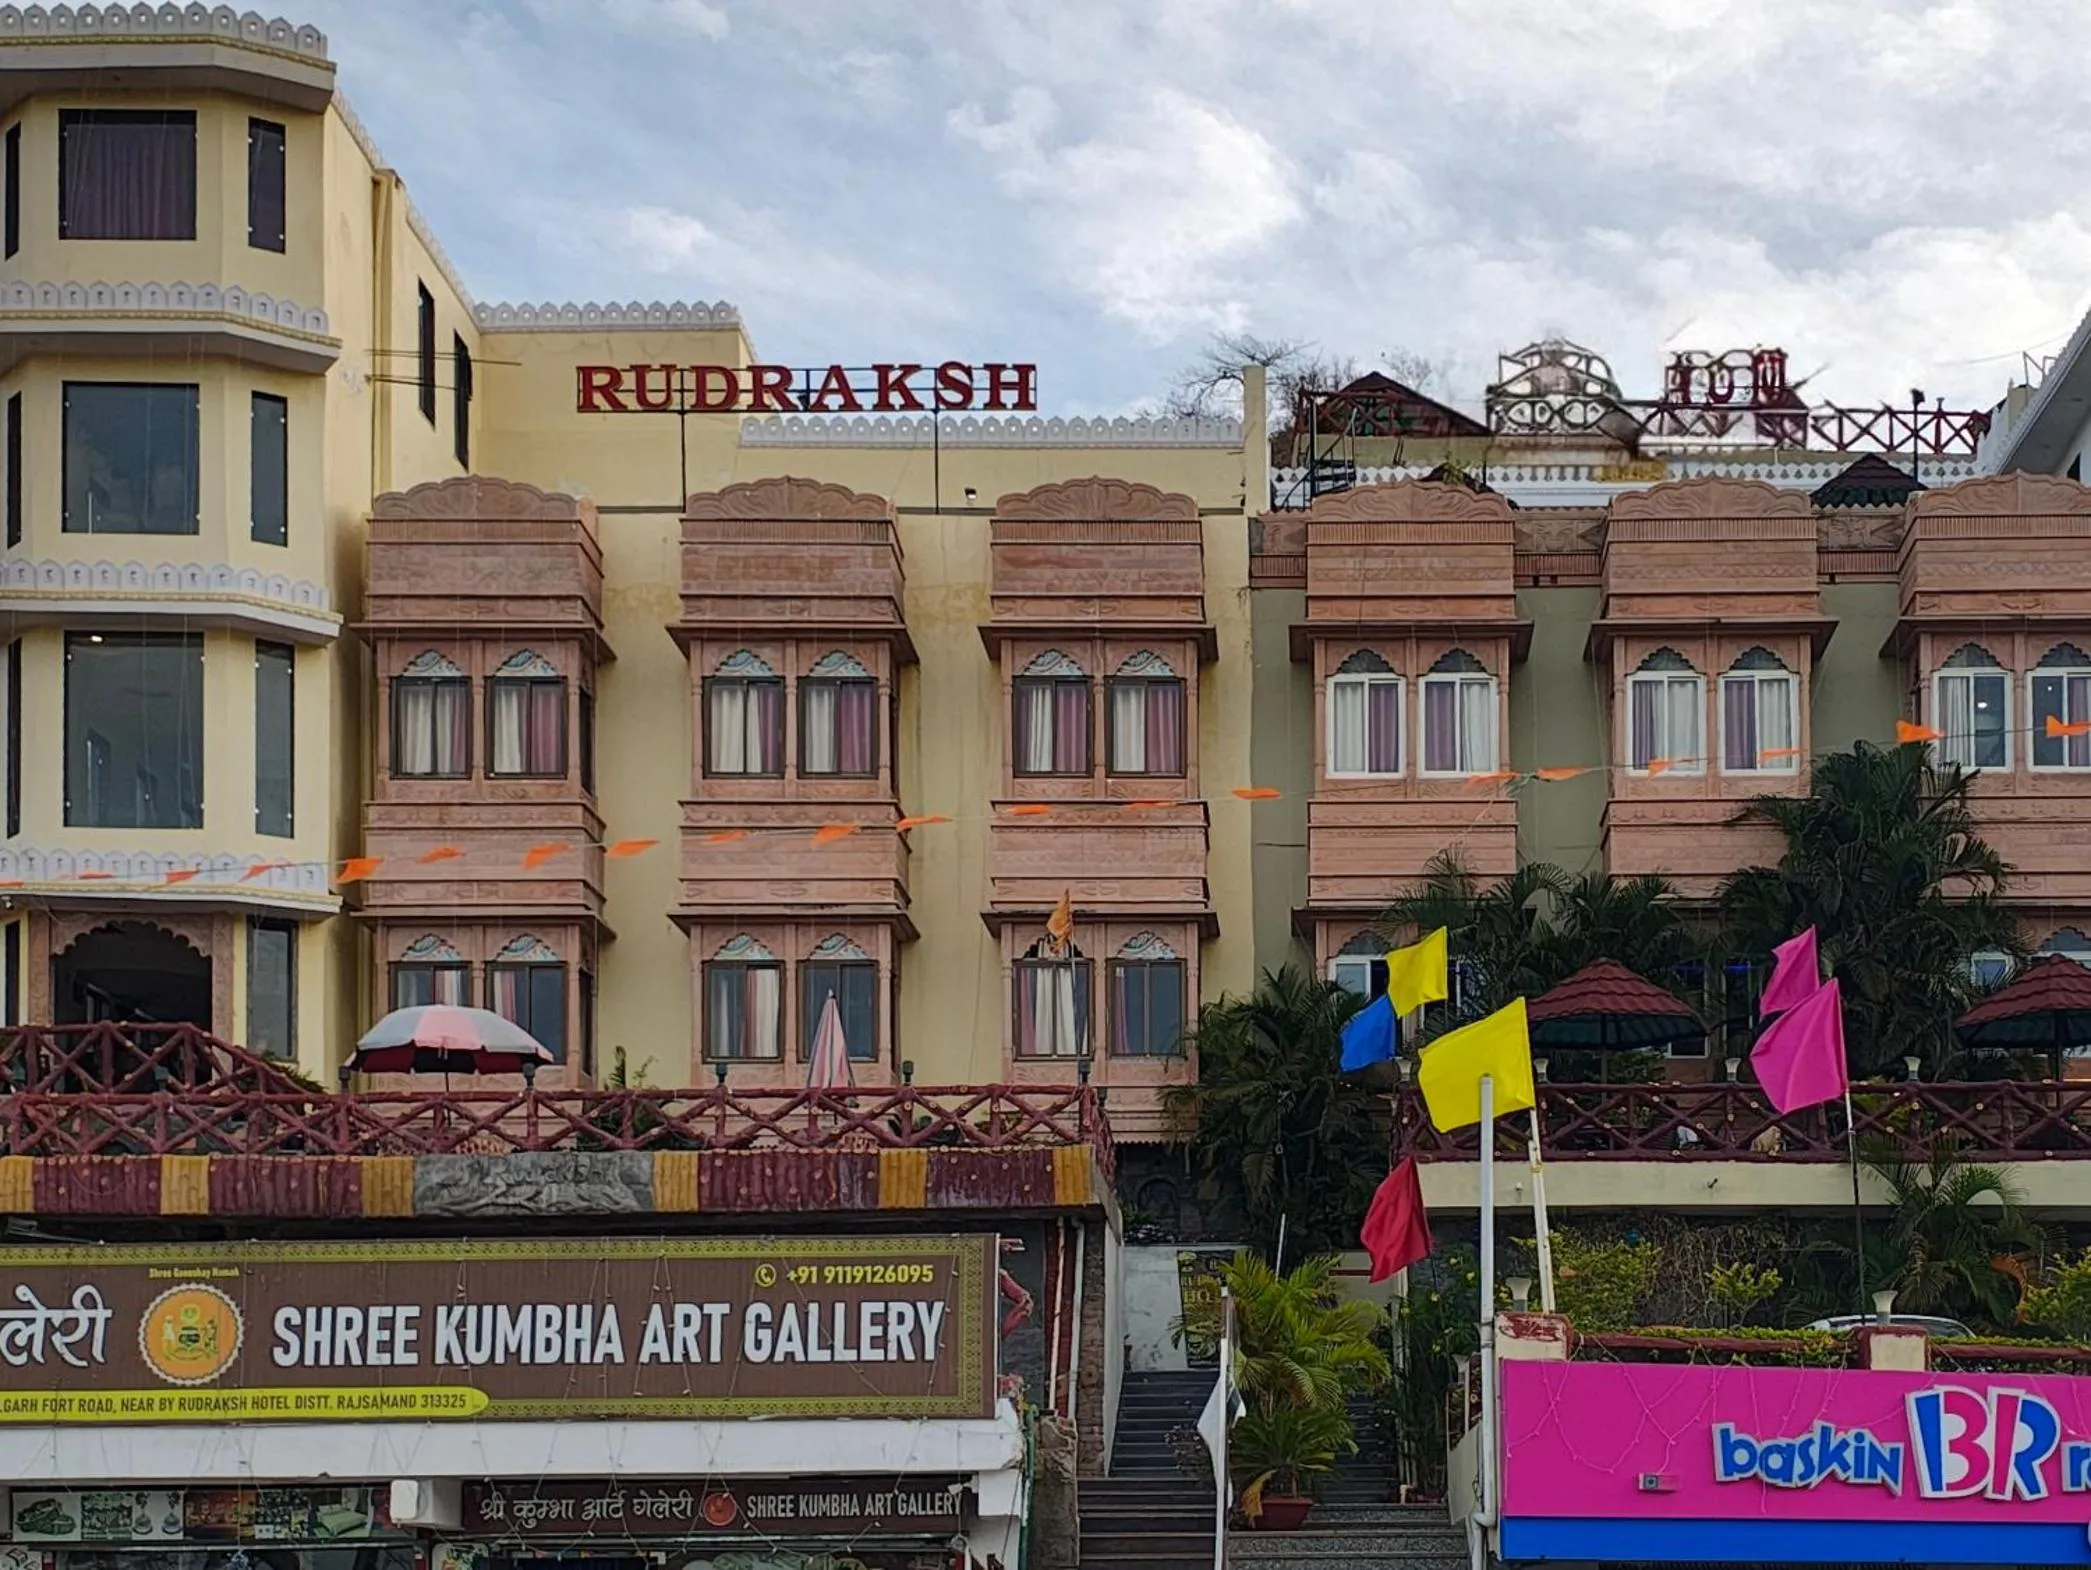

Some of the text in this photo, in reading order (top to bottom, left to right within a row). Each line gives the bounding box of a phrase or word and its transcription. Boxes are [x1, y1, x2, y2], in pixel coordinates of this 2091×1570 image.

[577, 362, 1037, 413] RUDRAKSH
[786, 1264, 935, 1284] +91 9119126095
[272, 1300, 946, 1368] SHREE KUMBHA ART GALLERY
[0, 1397, 38, 1413] GARH
[42, 1397, 75, 1413] FORT
[78, 1397, 117, 1414] ROAD,
[121, 1396, 154, 1412] NEAR
[158, 1396, 175, 1411] BY
[178, 1395, 248, 1411] RUDRAKSH
[252, 1395, 289, 1411] HOTEL
[337, 1394, 417, 1410] RAJSAMAND
[420, 1393, 467, 1409] 313325
[480, 1491, 507, 1519] श्री
[512, 1499, 576, 1529] कुम्भा
[747, 1491, 963, 1519] SHREE KUMBHA ART GALLERY
